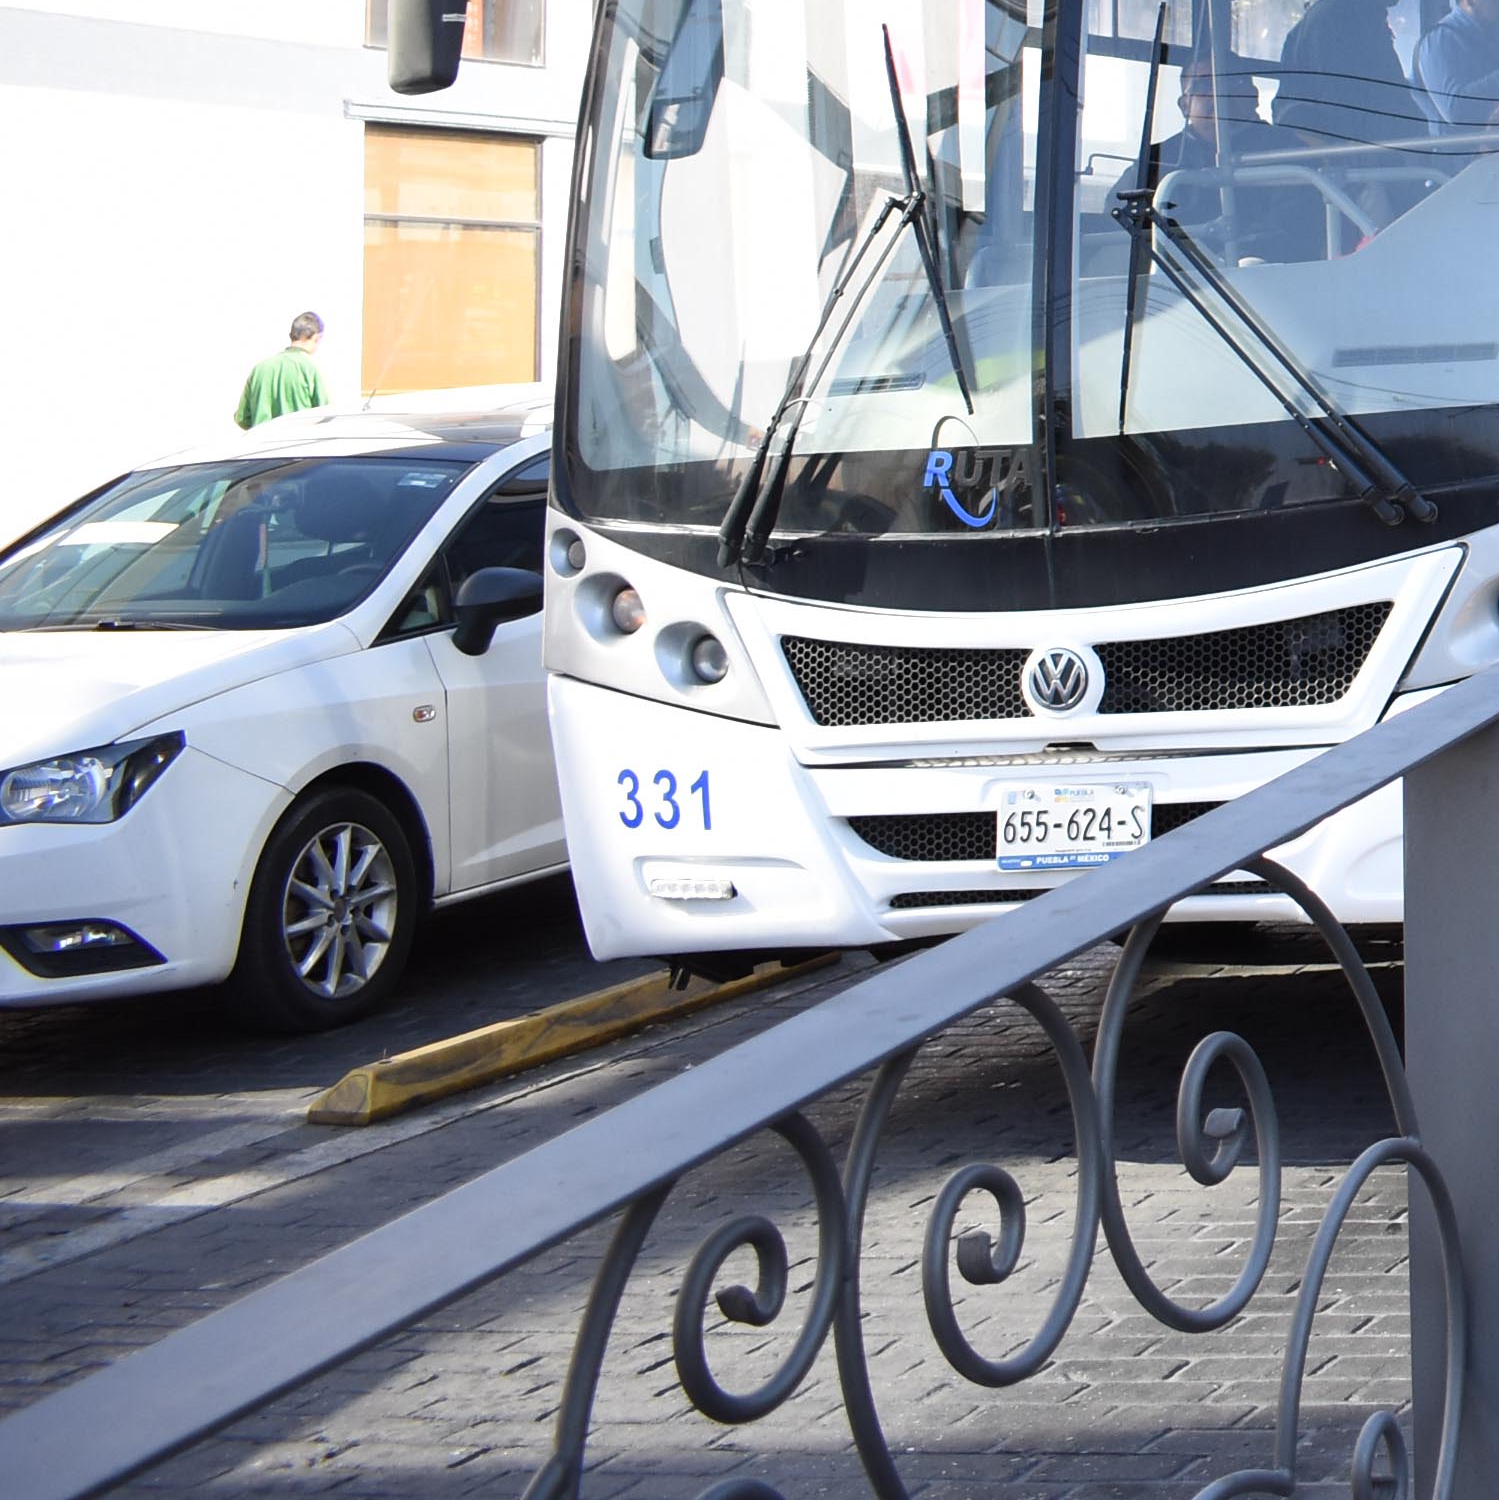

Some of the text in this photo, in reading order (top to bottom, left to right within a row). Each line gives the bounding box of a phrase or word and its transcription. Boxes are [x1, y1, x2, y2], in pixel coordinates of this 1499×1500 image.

[922, 448, 1033, 488] RUTA
[616, 767, 713, 832] 331
[1003, 804, 1146, 844] 655-624-S
[1035, 855, 1069, 865] PUEBLA
[1077, 853, 1110, 863] MÉXICO
